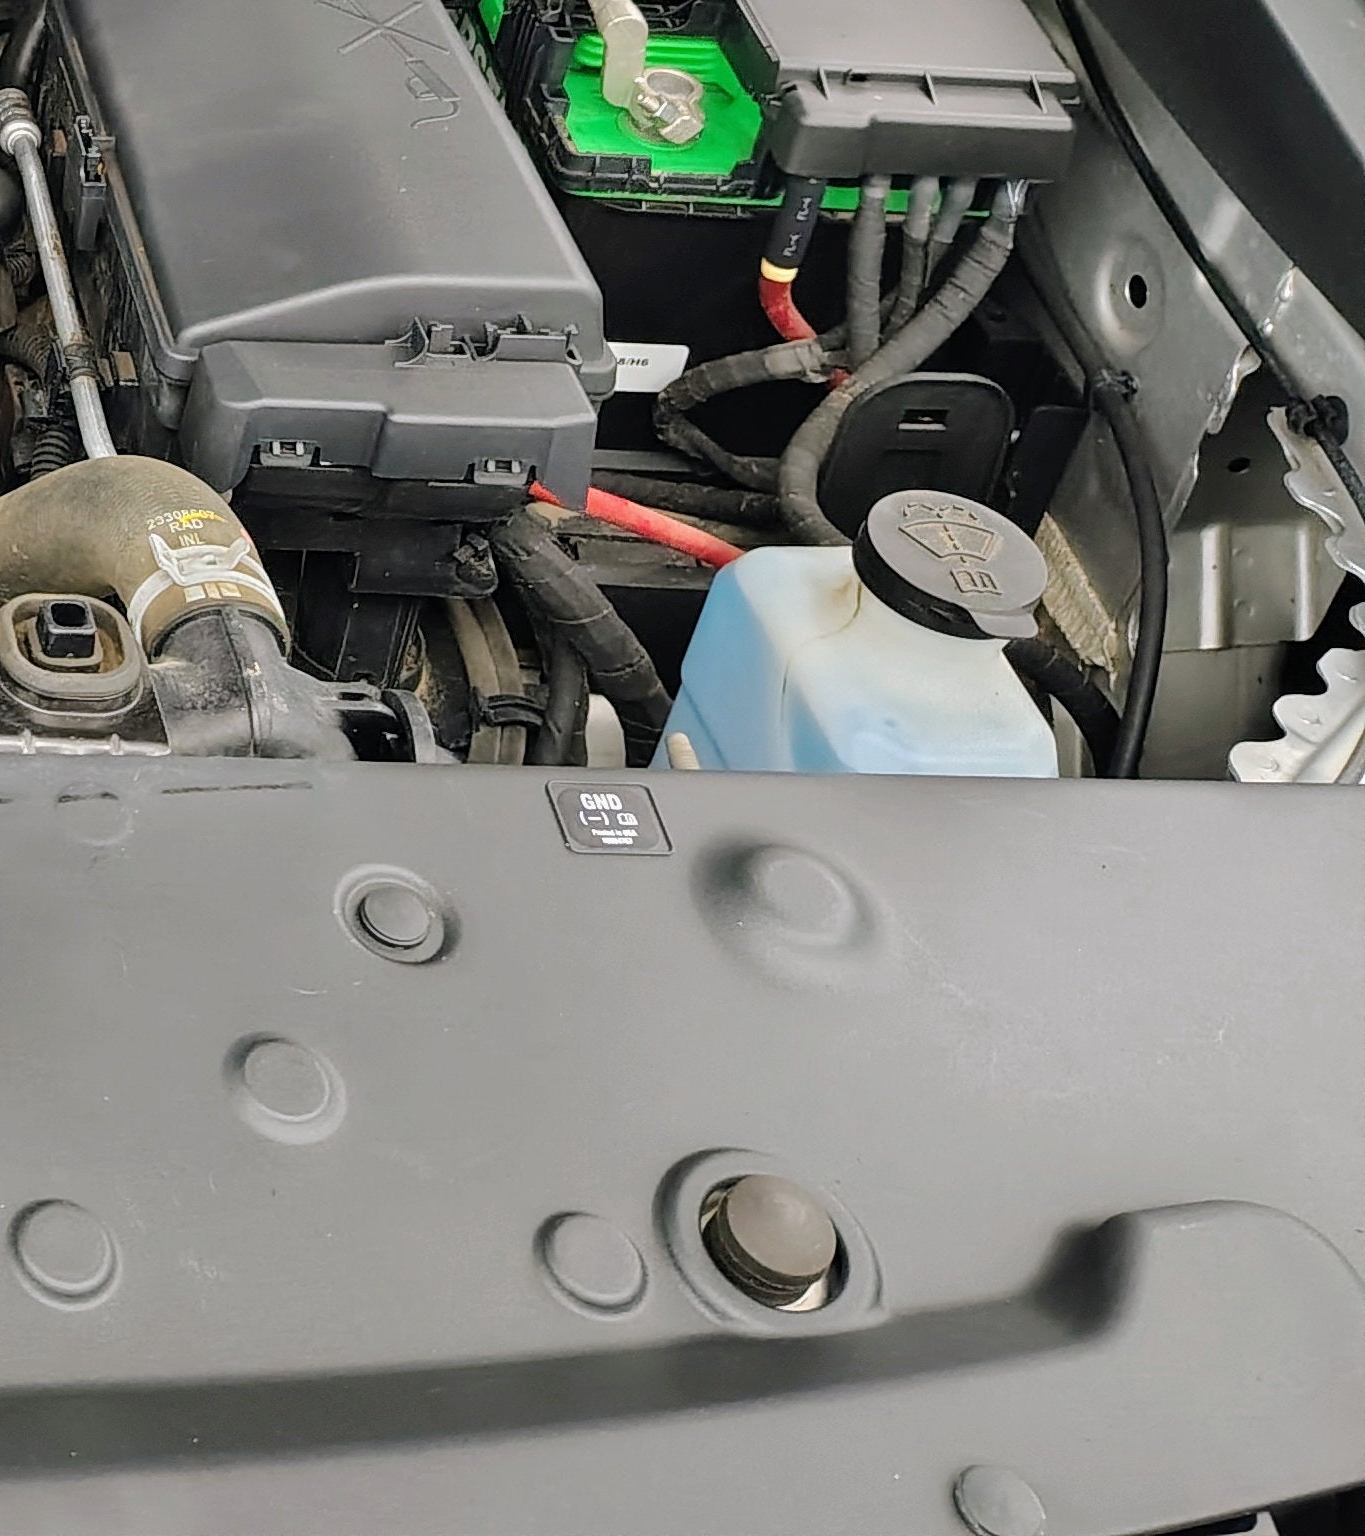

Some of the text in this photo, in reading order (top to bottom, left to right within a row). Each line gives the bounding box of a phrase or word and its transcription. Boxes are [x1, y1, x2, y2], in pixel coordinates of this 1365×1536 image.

[168, 518, 205, 534] RAD
[178, 532, 206, 547] INL
[579, 793, 623, 810] GND
